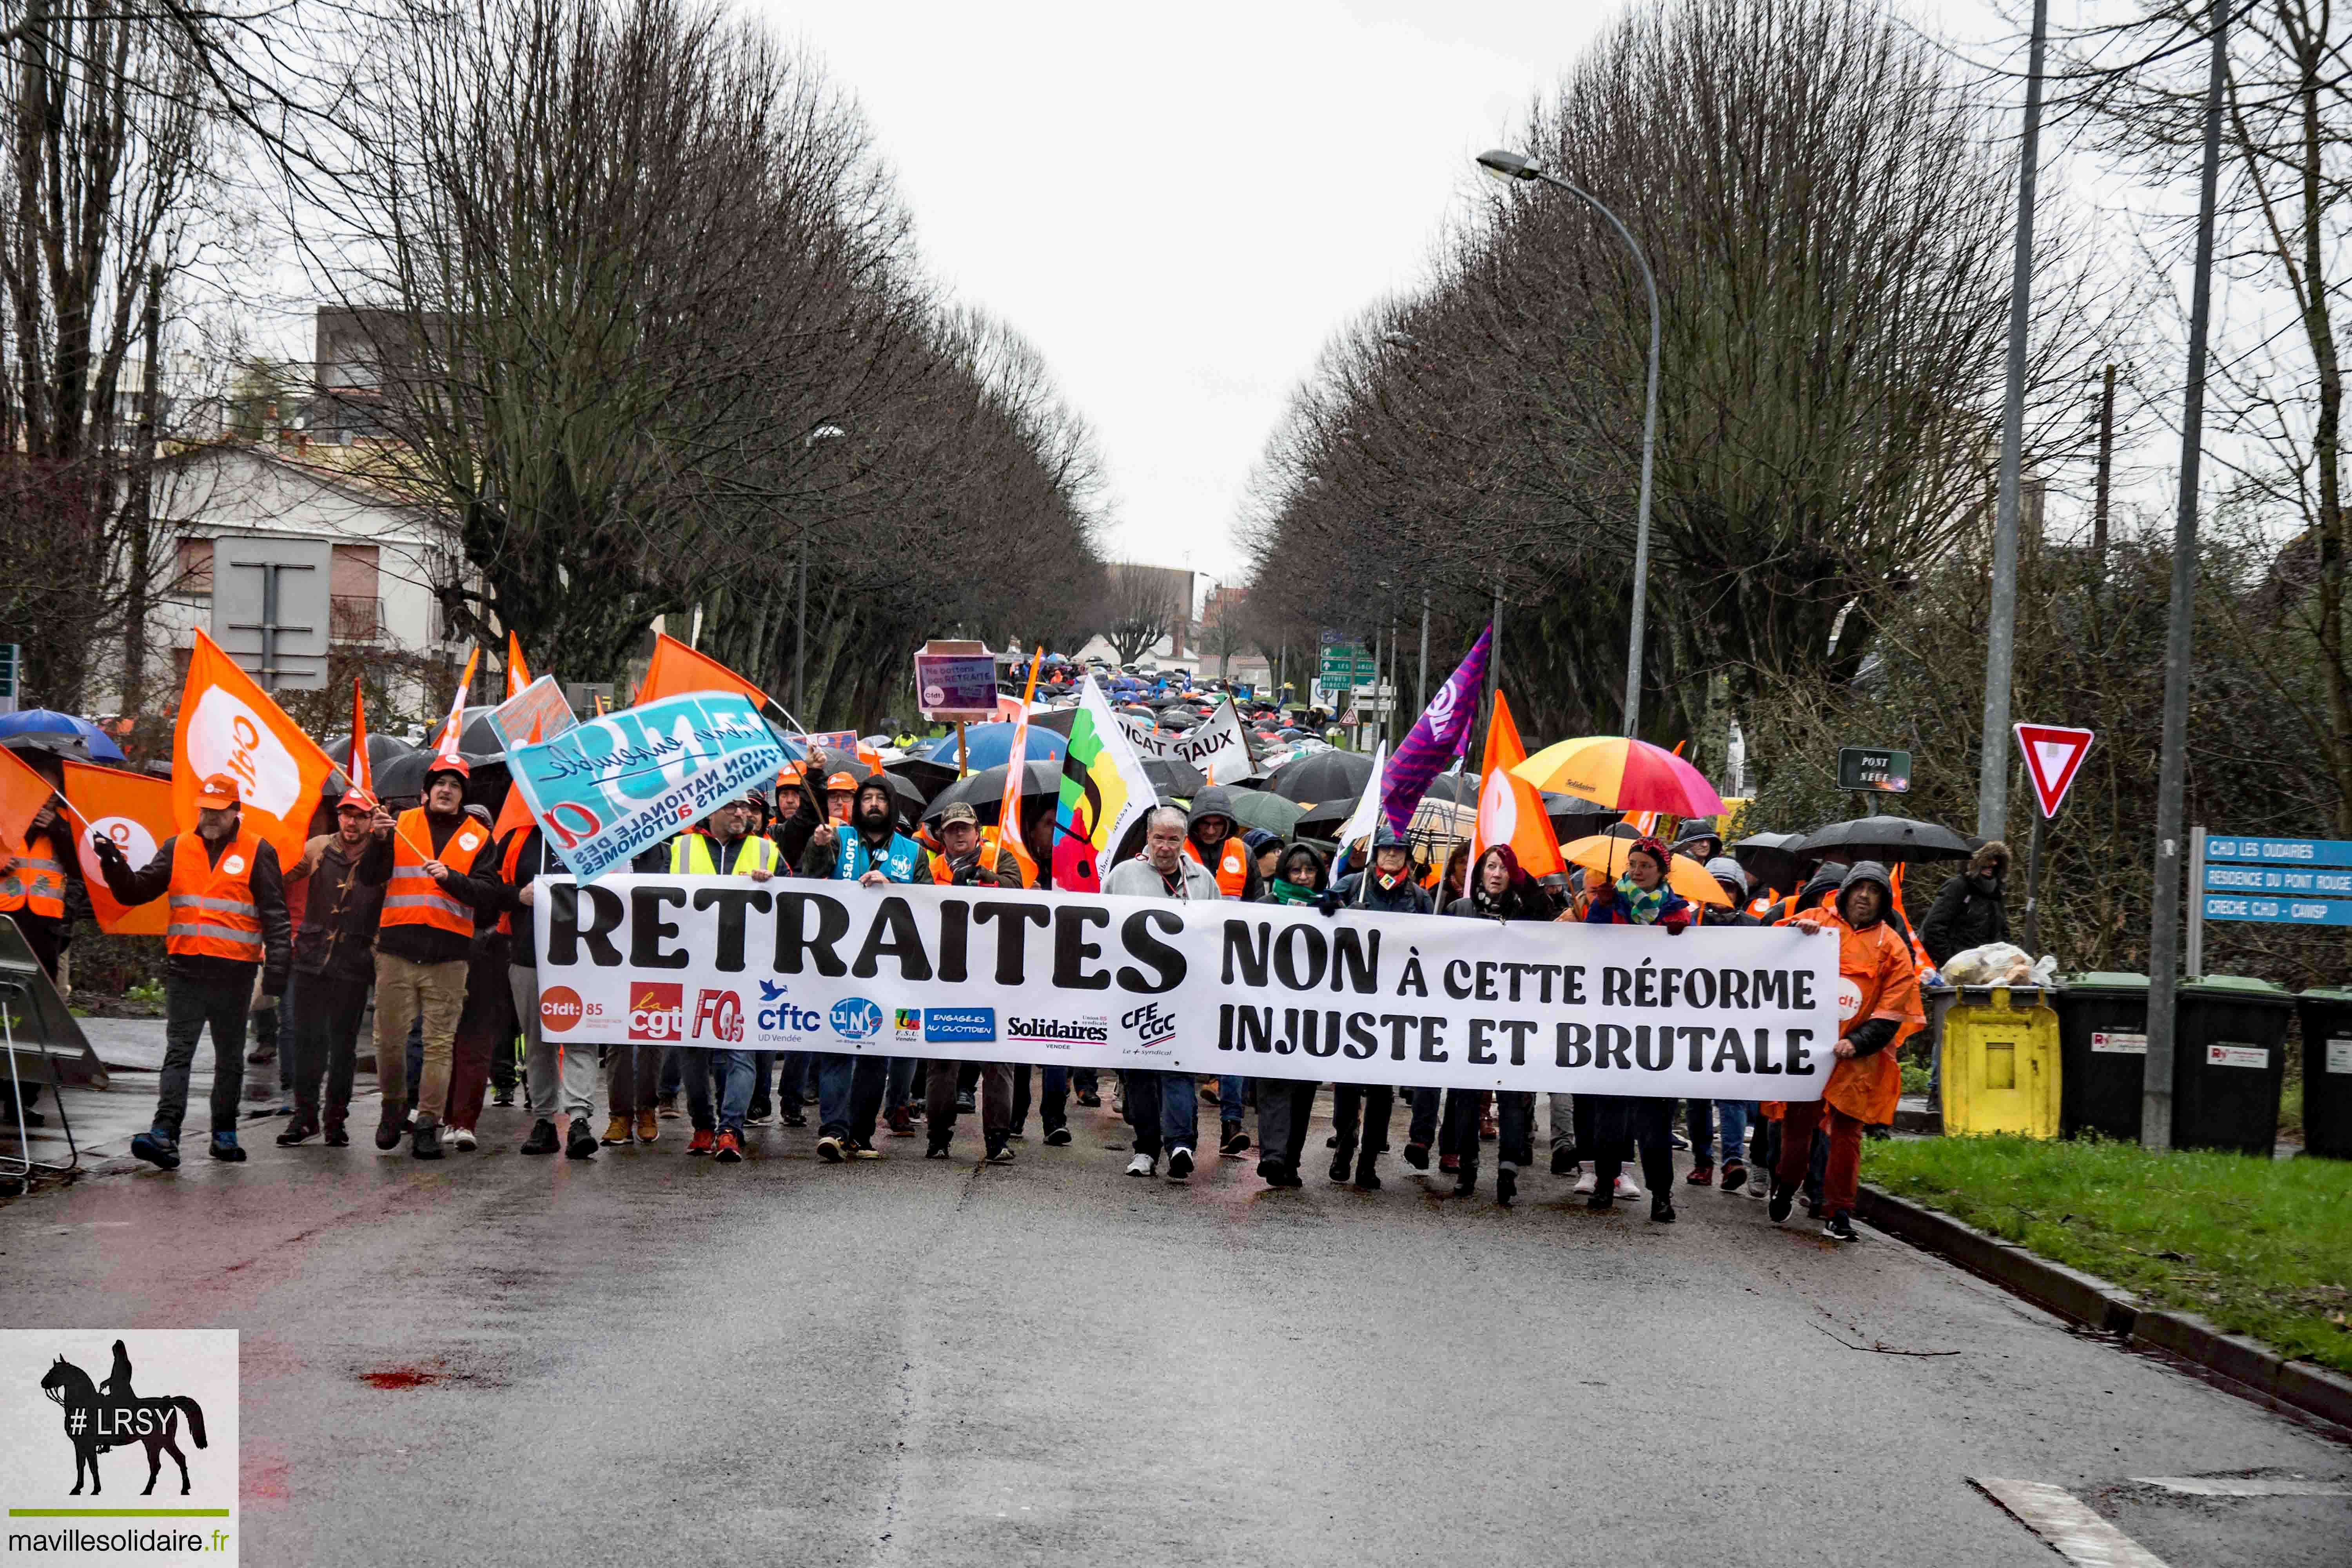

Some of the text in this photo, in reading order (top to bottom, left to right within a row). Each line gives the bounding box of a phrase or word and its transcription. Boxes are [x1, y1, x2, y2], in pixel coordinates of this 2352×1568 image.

[843, 838, 858, 880] sa.org
[2239, 842, 2259, 857] LES
[2266, 873, 2281, 887] DU
[2285, 874, 2314, 888] PONT
[547, 883, 1187, 994] RETRAITES
[1220, 919, 1816, 1010] NON À CETTE RÉFORME
[541, 1002, 603, 1016] Cfdt: 85
[628, 1006, 683, 1038] cgt
[691, 988, 741, 1040] FO
[757, 1003, 821, 1032] cftc
[1121, 1002, 1158, 1029] CFE
[721, 1013, 744, 1042] 85
[772, 1034, 802, 1043] Vendée
[942, 1025, 991, 1034] QUOTIDIEN
[1007, 1016, 1107, 1041] Solidaires
[1138, 1013, 1175, 1040] CGC
[1218, 1004, 1815, 1075] INJUSTE ET BRUTALE
